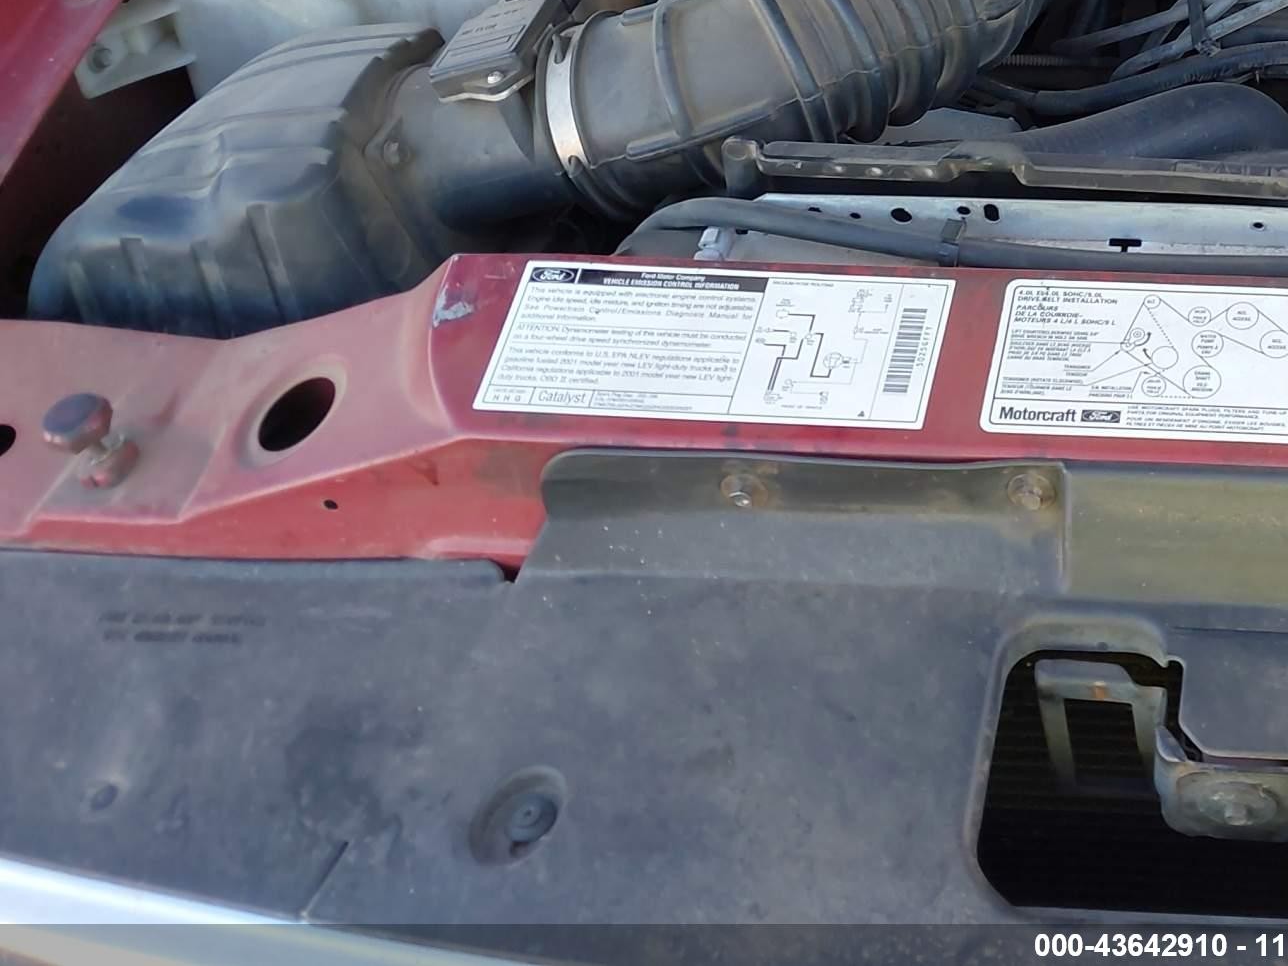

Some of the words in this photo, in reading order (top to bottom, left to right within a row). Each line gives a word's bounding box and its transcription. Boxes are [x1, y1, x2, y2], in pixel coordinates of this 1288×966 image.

[538, 269, 566, 280] Ford
[602, 277, 630, 285] VEHICLE
[630, 278, 662, 286] EMISSION
[662, 280, 693, 288] CONTROL
[693, 281, 739, 290] INFORMATION
[536, 390, 587, 404] Catalyst
[998, 406, 1076, 421] Motorcraft
